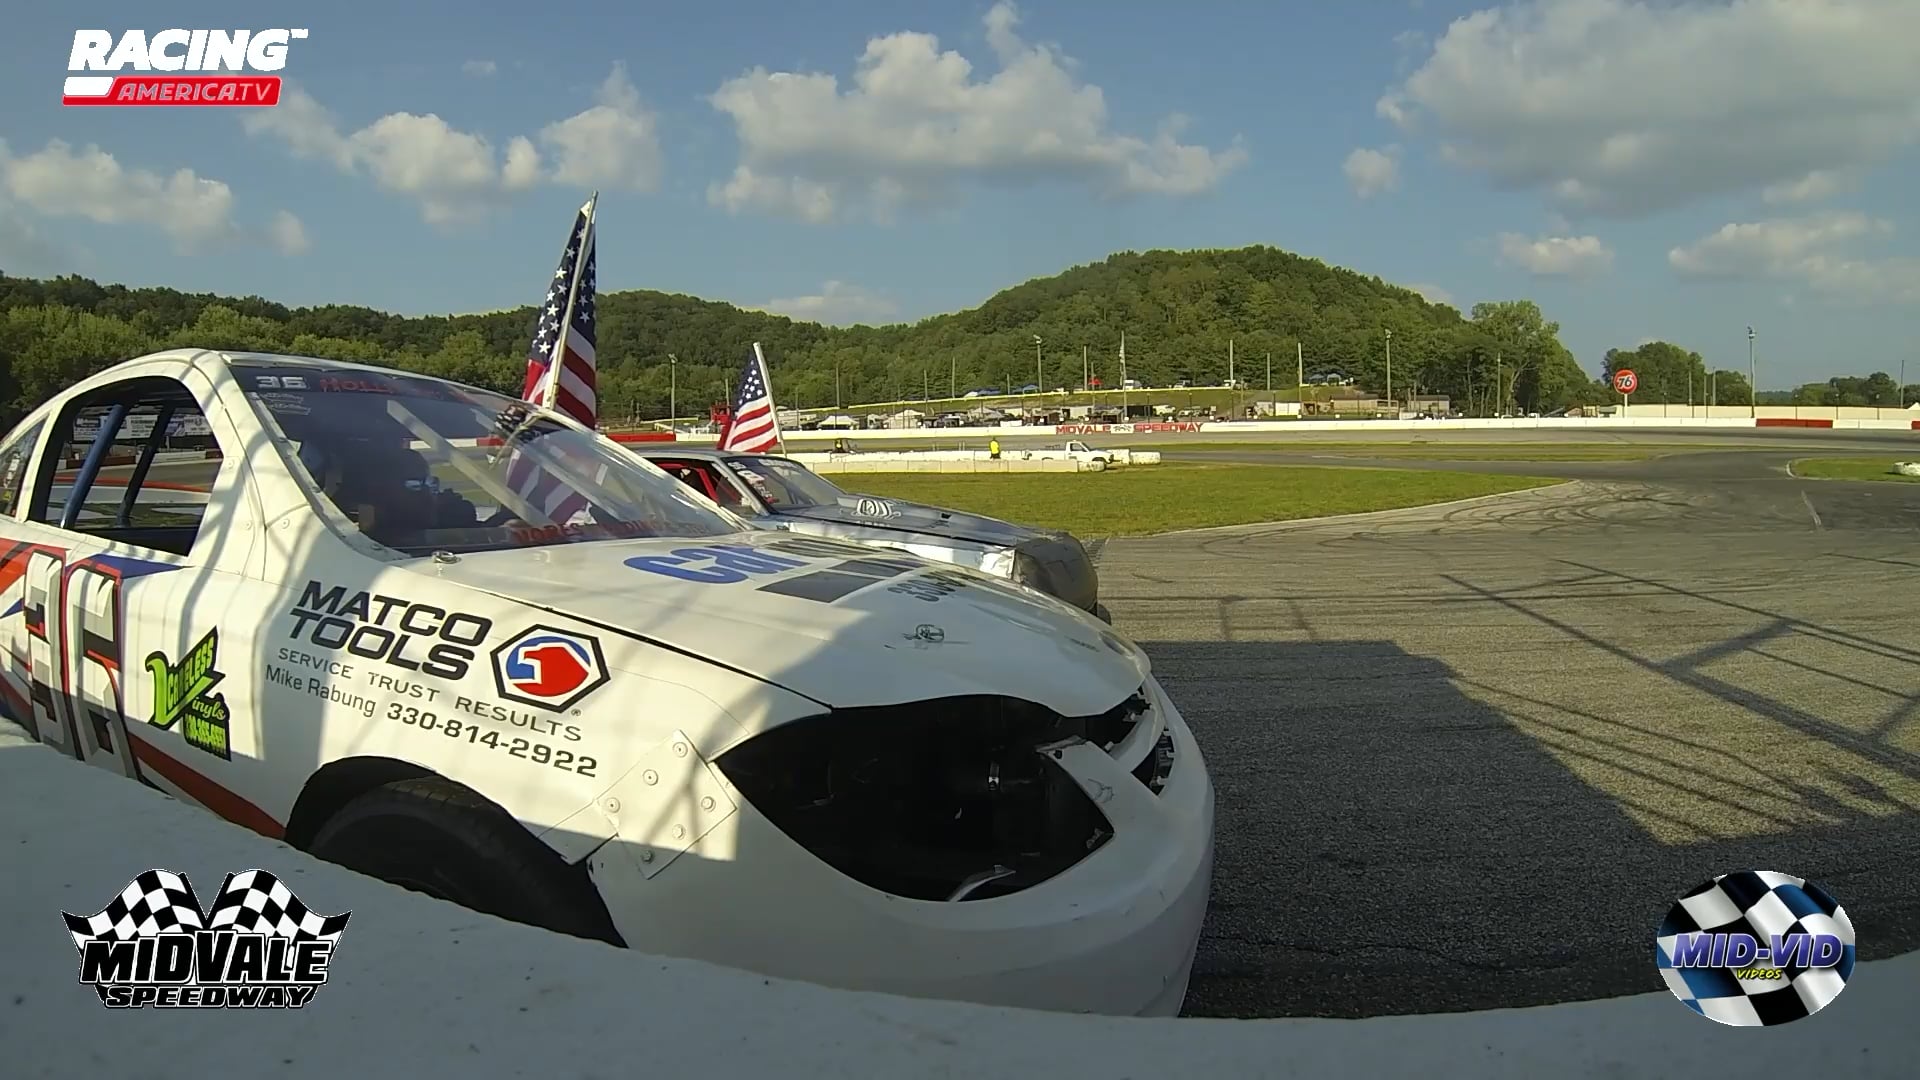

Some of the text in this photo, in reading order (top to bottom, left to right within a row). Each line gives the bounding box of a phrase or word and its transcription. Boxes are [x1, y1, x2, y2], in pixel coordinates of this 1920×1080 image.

[256, 375, 307, 390] 36
[1616, 375, 1633, 389] 76
[1056, 422, 1202, 435] MIDVALE SPEEDWAY
[288, 608, 476, 681] TOOLS
[297, 580, 493, 647] MATCO
[168, 636, 214, 711] CARELESS
[279, 648, 582, 742] SERVICE TRUST RESULTS
[265, 664, 598, 778] Mike Rabung 330-814-2922
